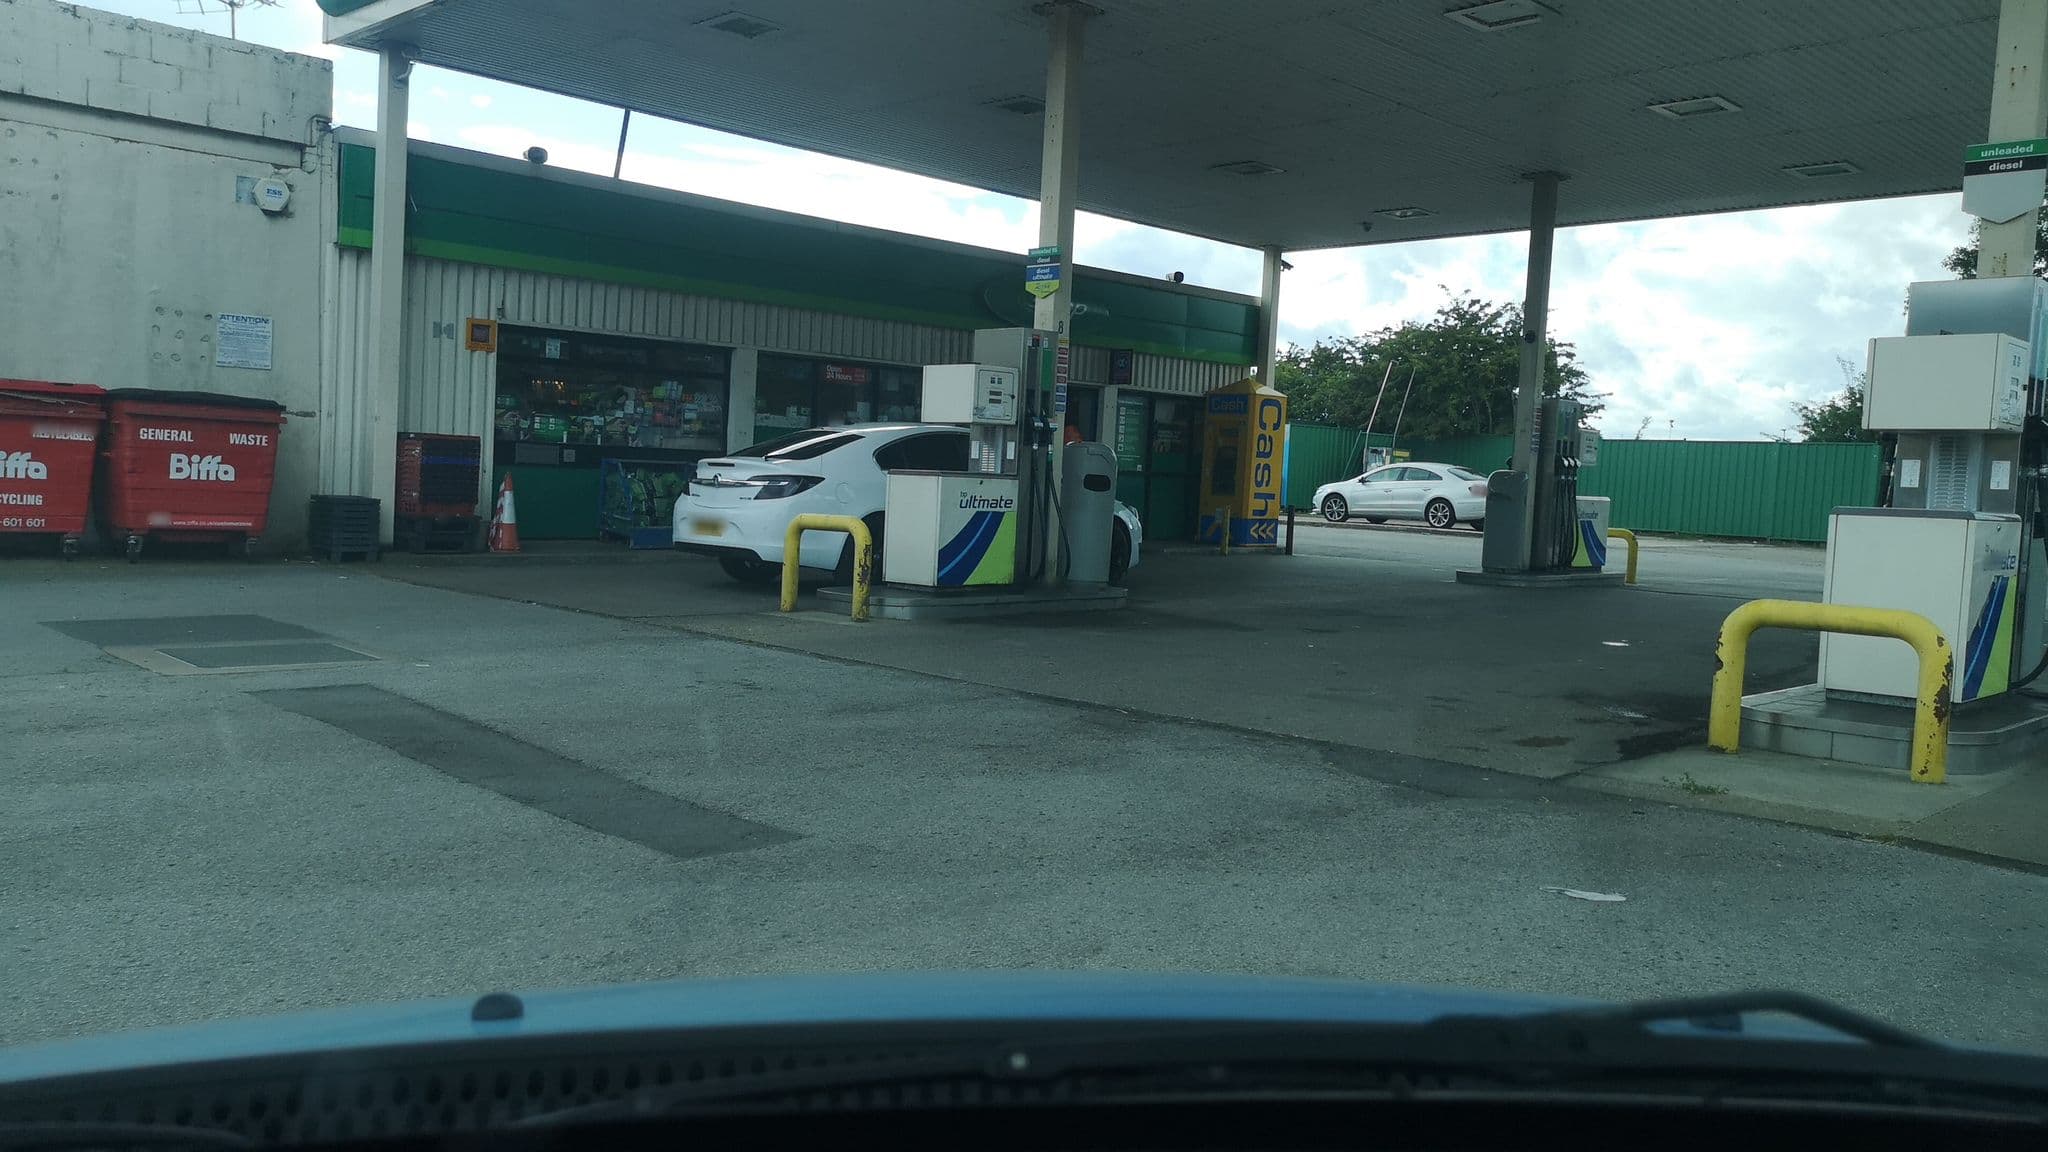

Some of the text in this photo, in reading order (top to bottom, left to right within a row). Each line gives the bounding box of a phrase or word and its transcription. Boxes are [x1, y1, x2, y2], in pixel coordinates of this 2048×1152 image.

[1980, 144, 2034, 157] unleaded
[1988, 160, 2023, 172] diesel
[1058, 320, 1064, 334] 8
[139, 428, 269, 447] GENERAL WASTE
[0, 450, 48, 480] iffa
[1253, 399, 1283, 518] Cash
[169, 453, 236, 481] Biffa
[0, 493, 43, 506] YCLING
[959, 495, 1013, 509] ultimate
[26, 518, 47, 528] 601
